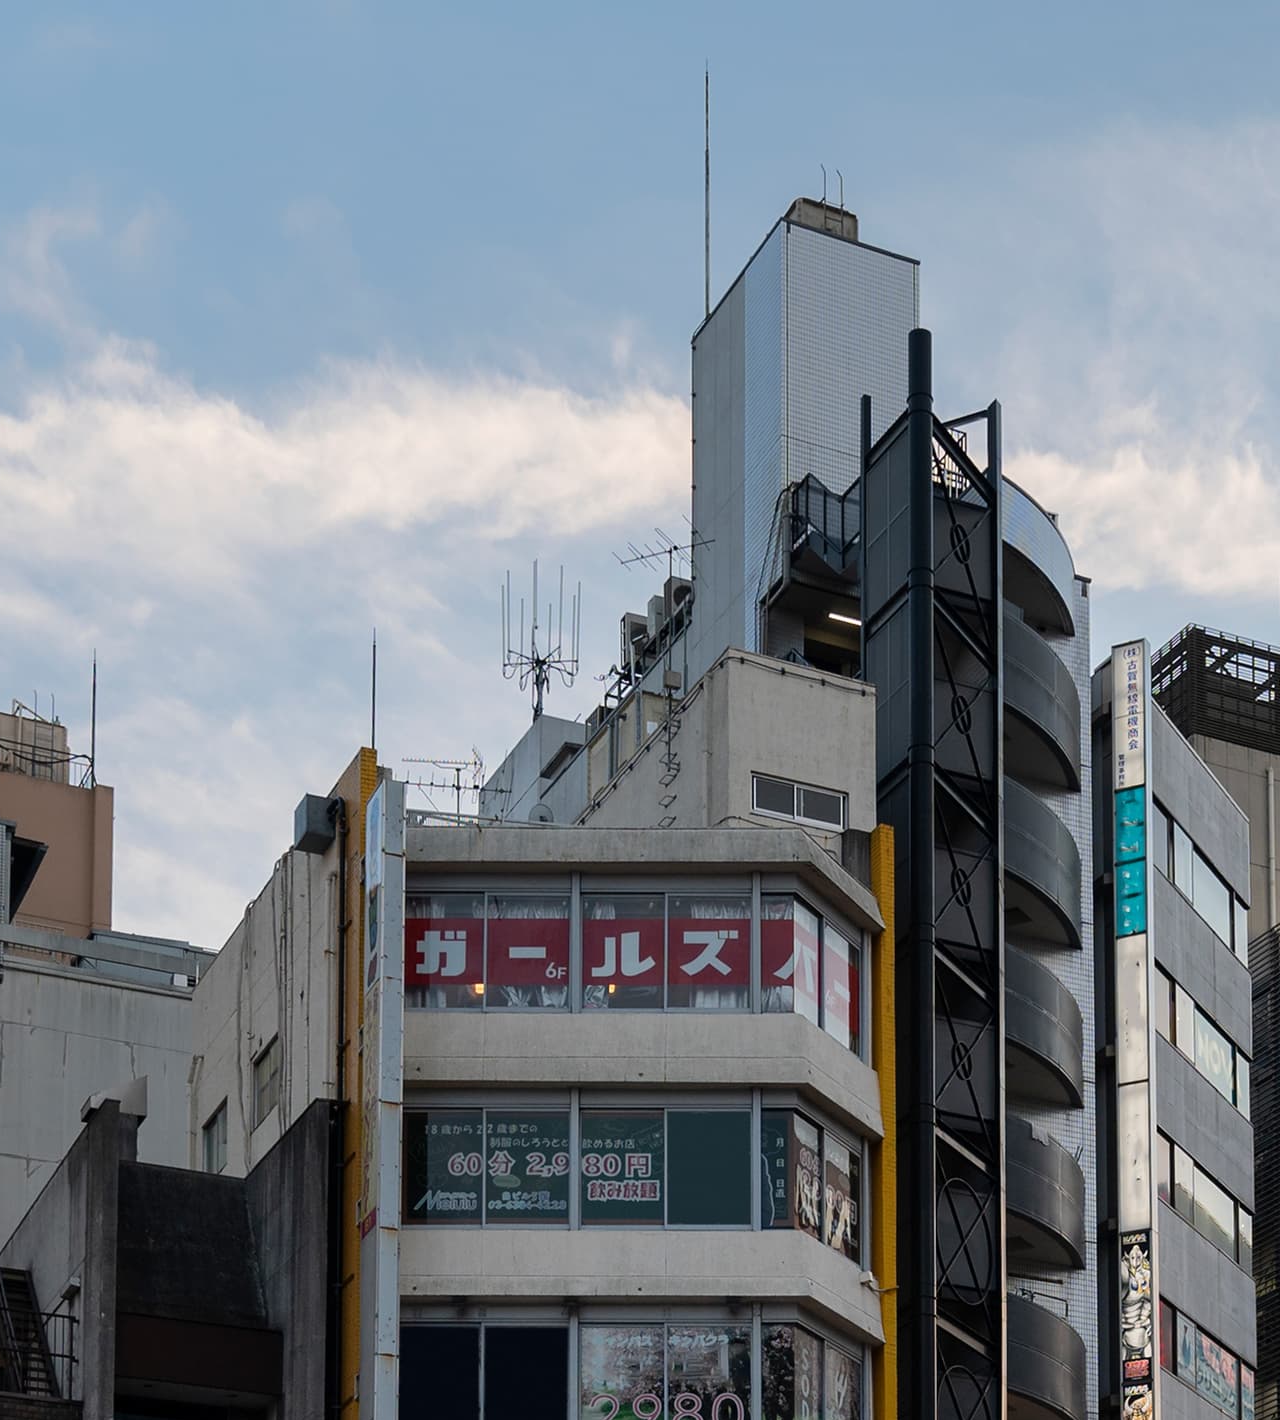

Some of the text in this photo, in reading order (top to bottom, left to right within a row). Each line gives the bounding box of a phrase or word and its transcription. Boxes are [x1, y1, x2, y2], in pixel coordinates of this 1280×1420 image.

[545, 963, 566, 979] 6F
[448, 1150, 652, 1177] 60分 2,980円
[587, 1180, 660, 1202] 飲み放題
